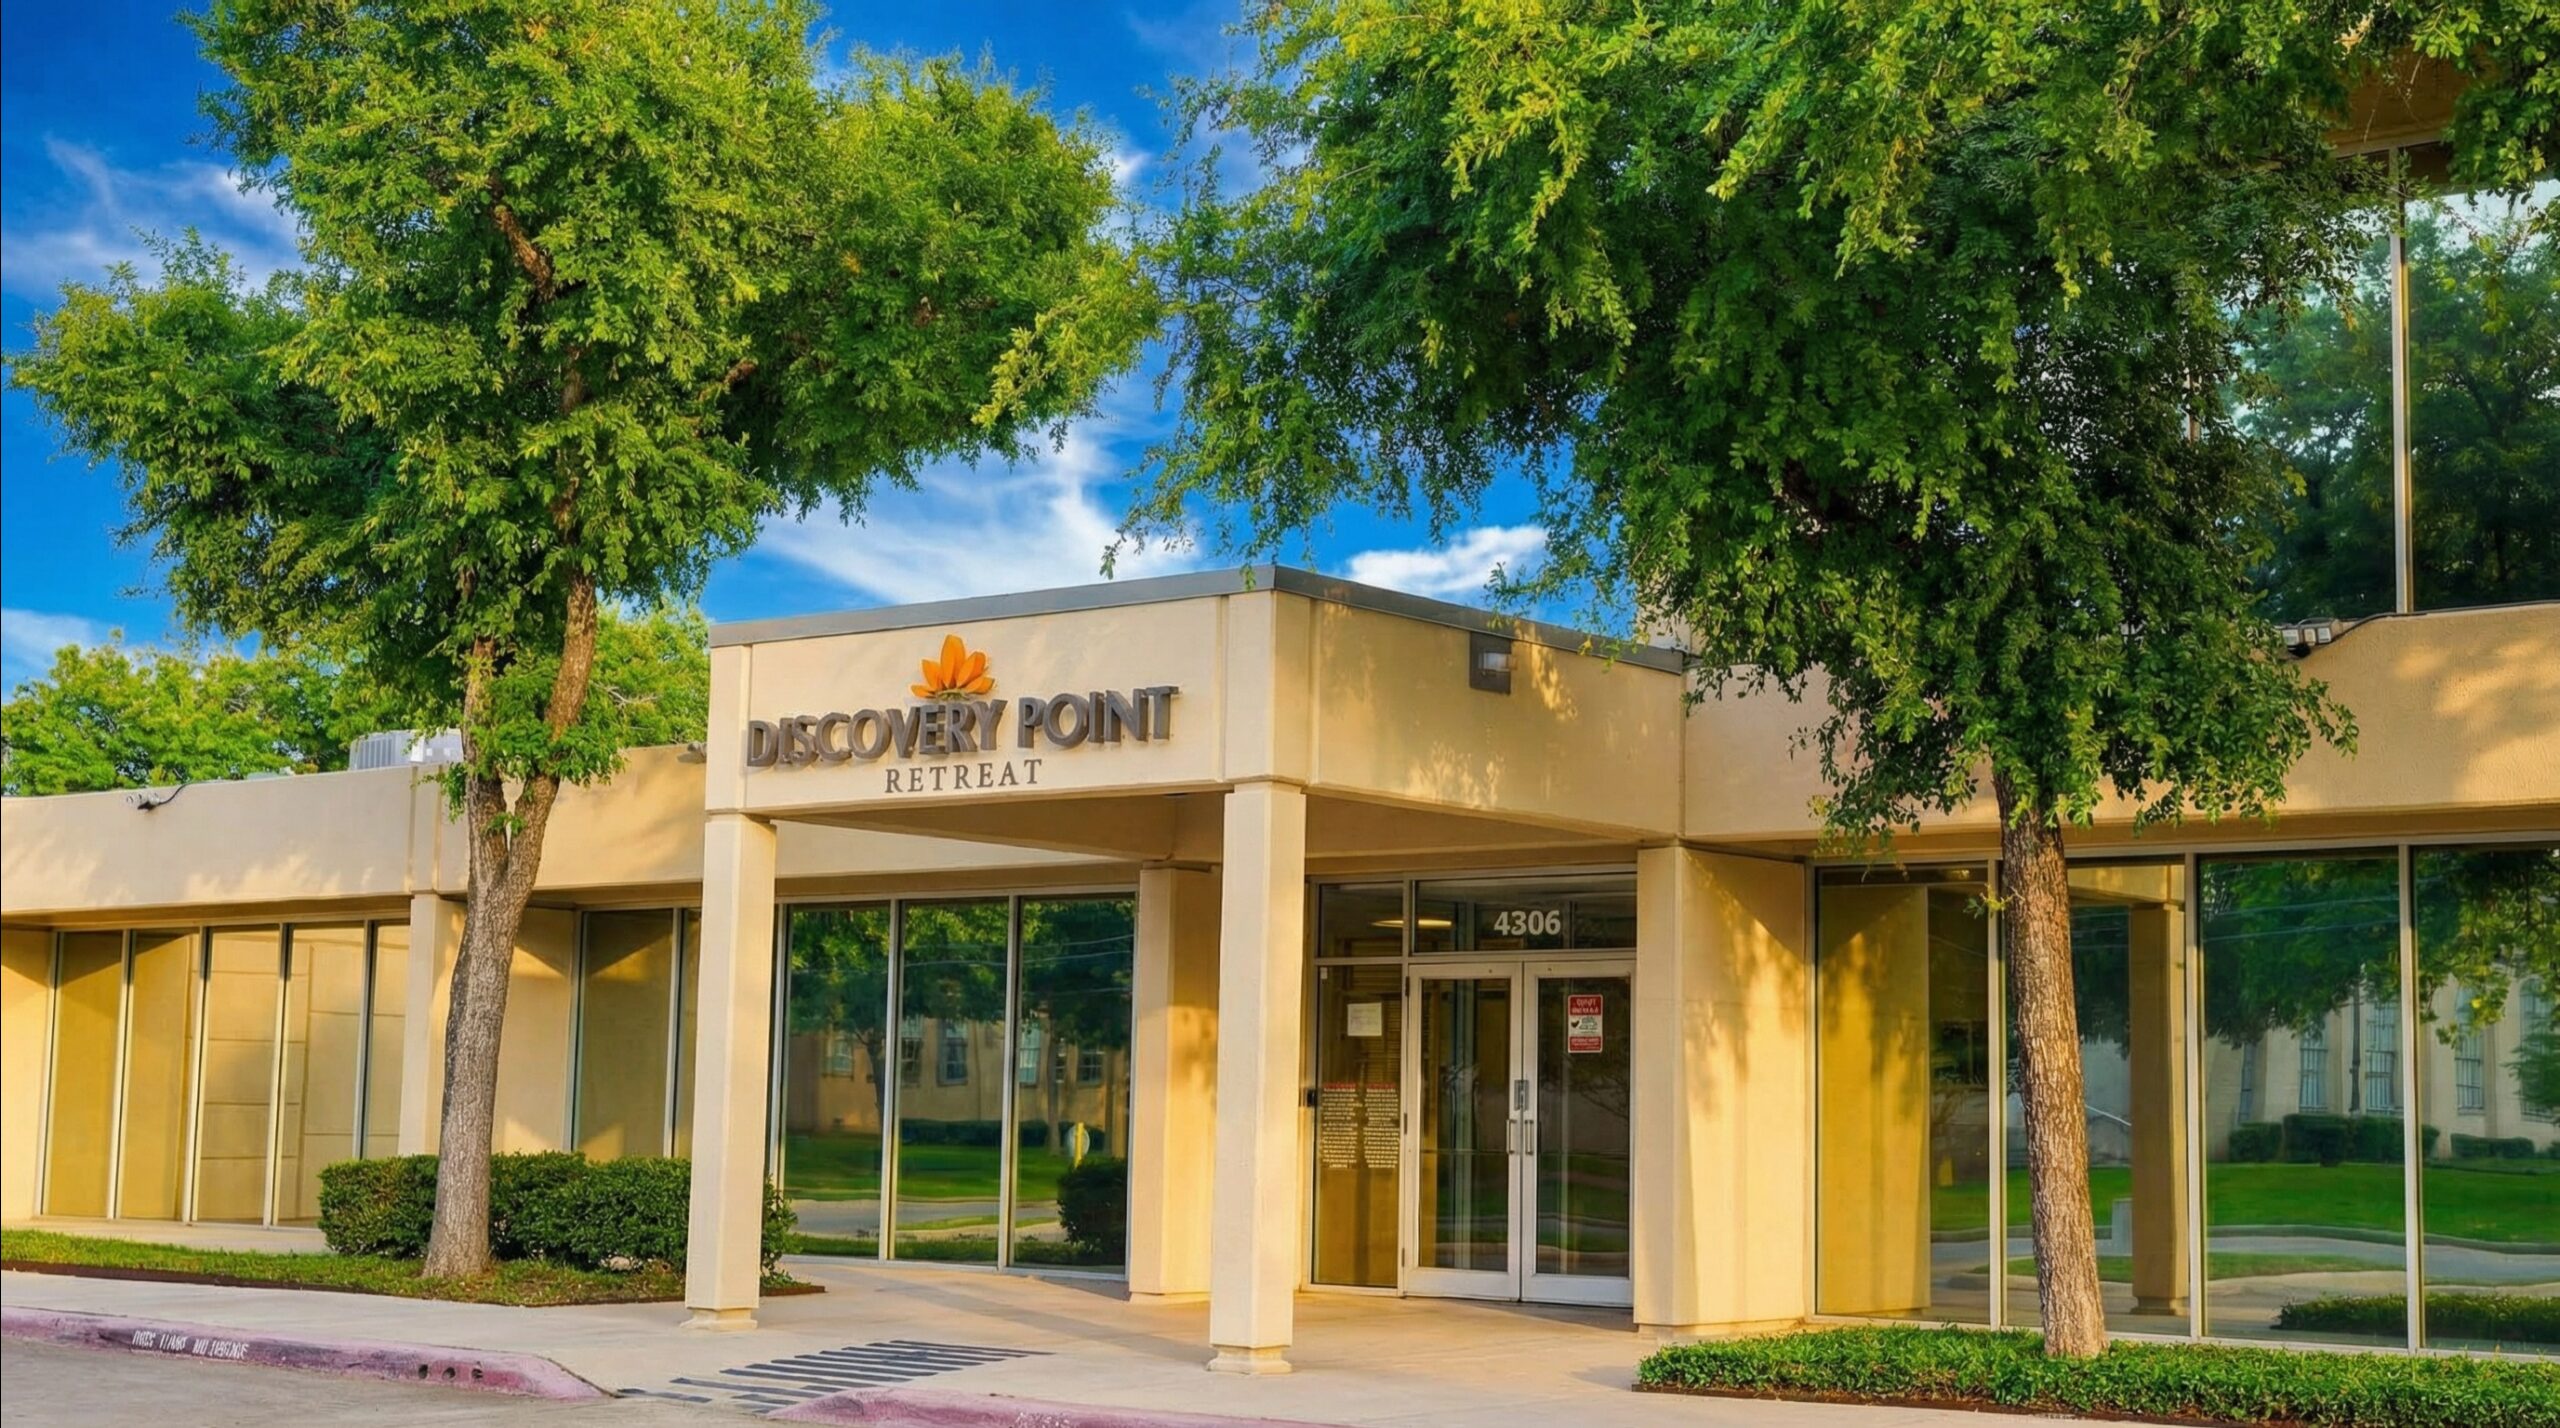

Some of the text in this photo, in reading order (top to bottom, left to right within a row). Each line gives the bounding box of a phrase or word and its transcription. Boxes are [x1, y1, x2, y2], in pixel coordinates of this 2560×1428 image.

[747, 686, 1181, 767] DISCOVERY POINT
[885, 759, 1043, 794] RETREAT
[1494, 910, 1561, 936] 4306
